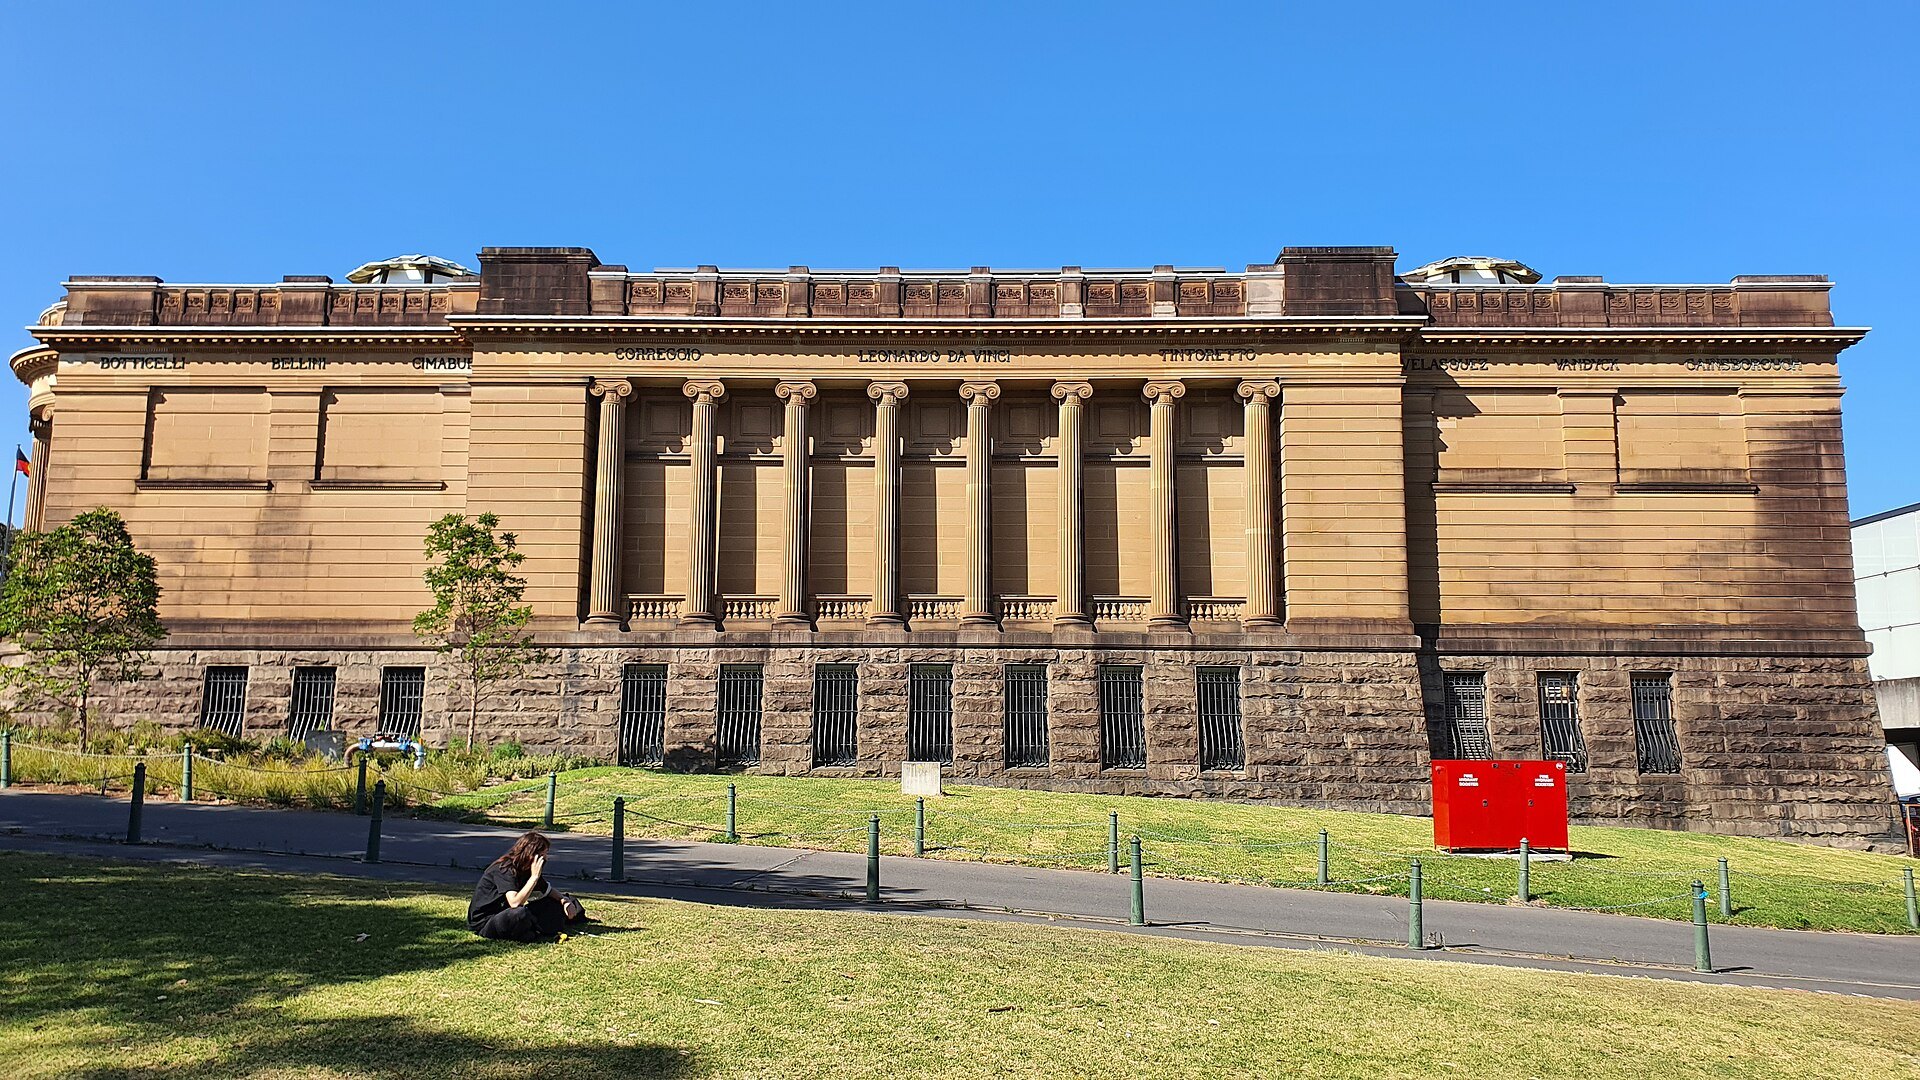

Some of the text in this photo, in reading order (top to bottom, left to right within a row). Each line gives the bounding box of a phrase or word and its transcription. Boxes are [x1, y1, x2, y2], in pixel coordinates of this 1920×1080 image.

[615, 348, 702, 361] CORREGGIO
[858, 350, 1010, 363] LEONARDO DA VINCI
[1159, 349, 1256, 361] TINTORETTO
[100, 357, 185, 370] BOTTICELLI
[271, 357, 326, 370] BELLINI
[1402, 358, 1489, 371] VELASQUEZ
[1553, 358, 1620, 371] VANDYCK
[1685, 358, 1803, 371] GAINSBOROUGH
